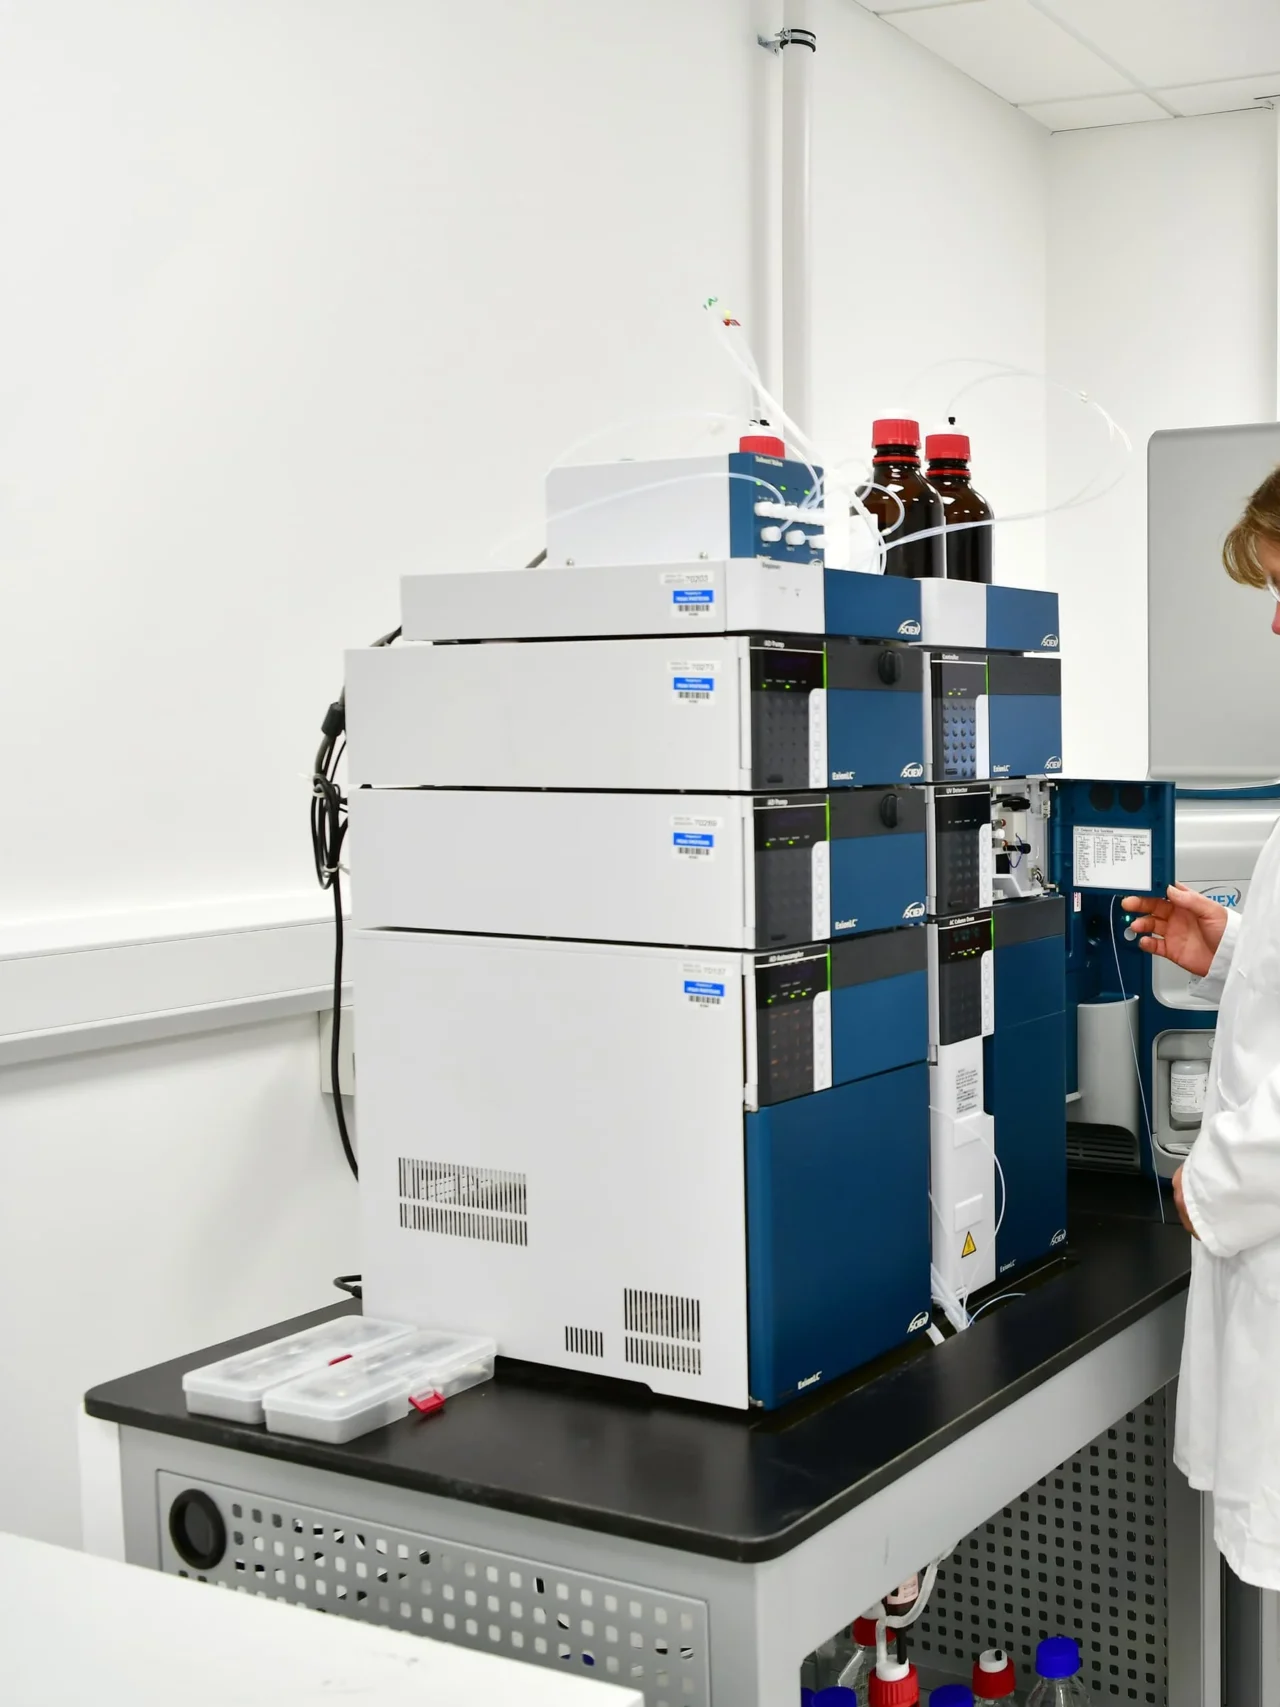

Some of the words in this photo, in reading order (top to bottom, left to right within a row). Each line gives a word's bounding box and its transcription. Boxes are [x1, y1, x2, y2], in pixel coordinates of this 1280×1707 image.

[899, 623, 921, 635] SCIEX
[1042, 637, 1058, 647] SCIEX
[1045, 759, 1062, 770] SCIEX
[902, 766, 923, 778] SCIEX
[903, 906, 925, 919] SCIEX
[1050, 1231, 1066, 1246] SCIEX
[907, 1314, 929, 1332] SCIEX
